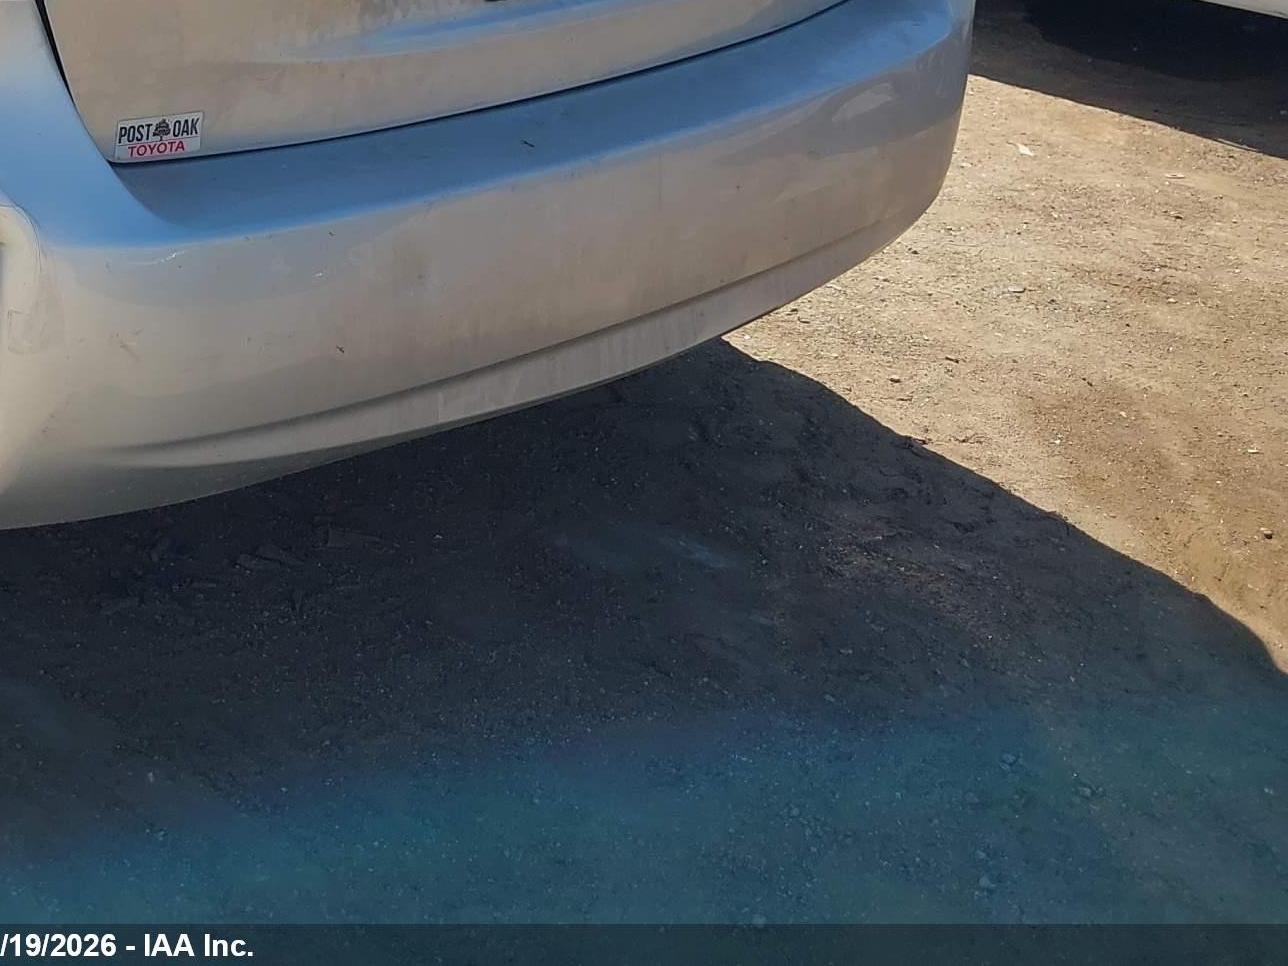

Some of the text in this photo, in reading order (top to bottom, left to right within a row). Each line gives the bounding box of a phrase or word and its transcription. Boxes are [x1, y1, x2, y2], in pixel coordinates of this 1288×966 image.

[118, 117, 200, 144] POST OAK
[128, 140, 185, 157] TOYOTA
